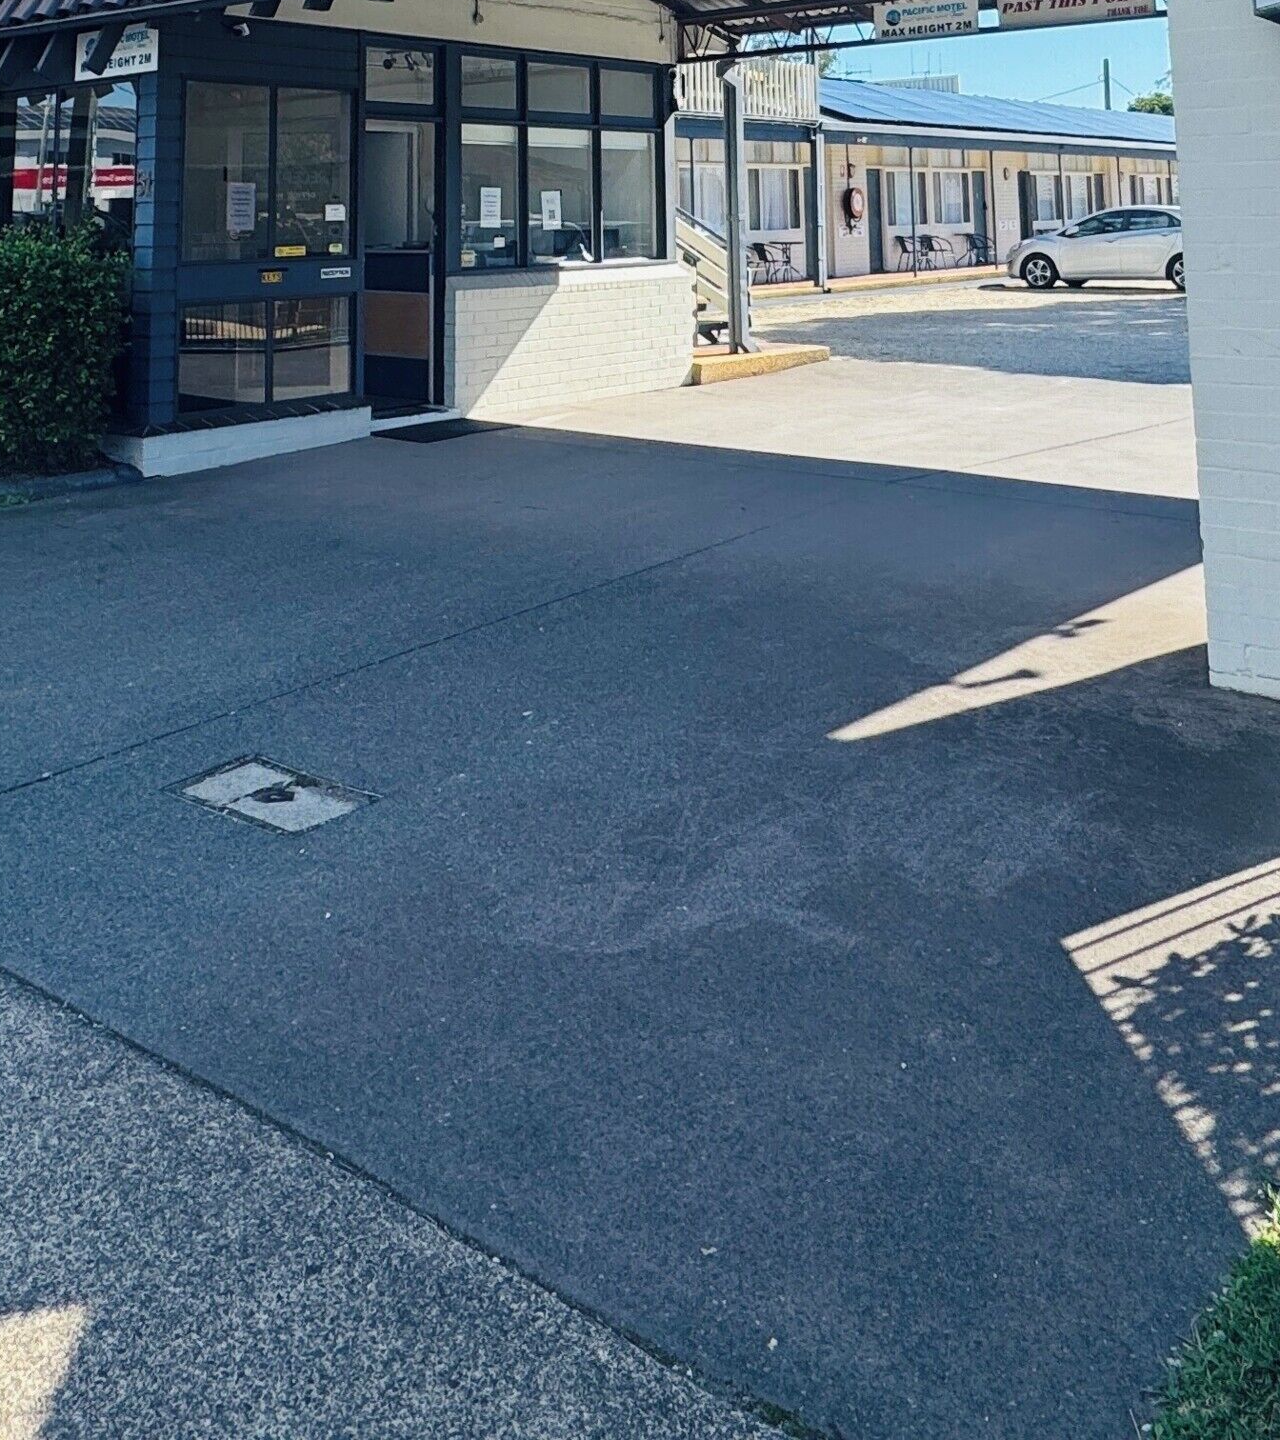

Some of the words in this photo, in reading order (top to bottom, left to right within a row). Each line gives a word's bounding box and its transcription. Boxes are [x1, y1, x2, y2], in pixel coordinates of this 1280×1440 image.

[902, 5, 935, 16] PACIFIC
[937, 2, 967, 12] MOTEL
[1002, 0, 1042, 14] PAST
[881, 27, 906, 37] MAX
[908, 23, 952, 35] HEIGHT
[956, 20, 972, 31] 2M
[108, 55, 137, 69] EIGHT
